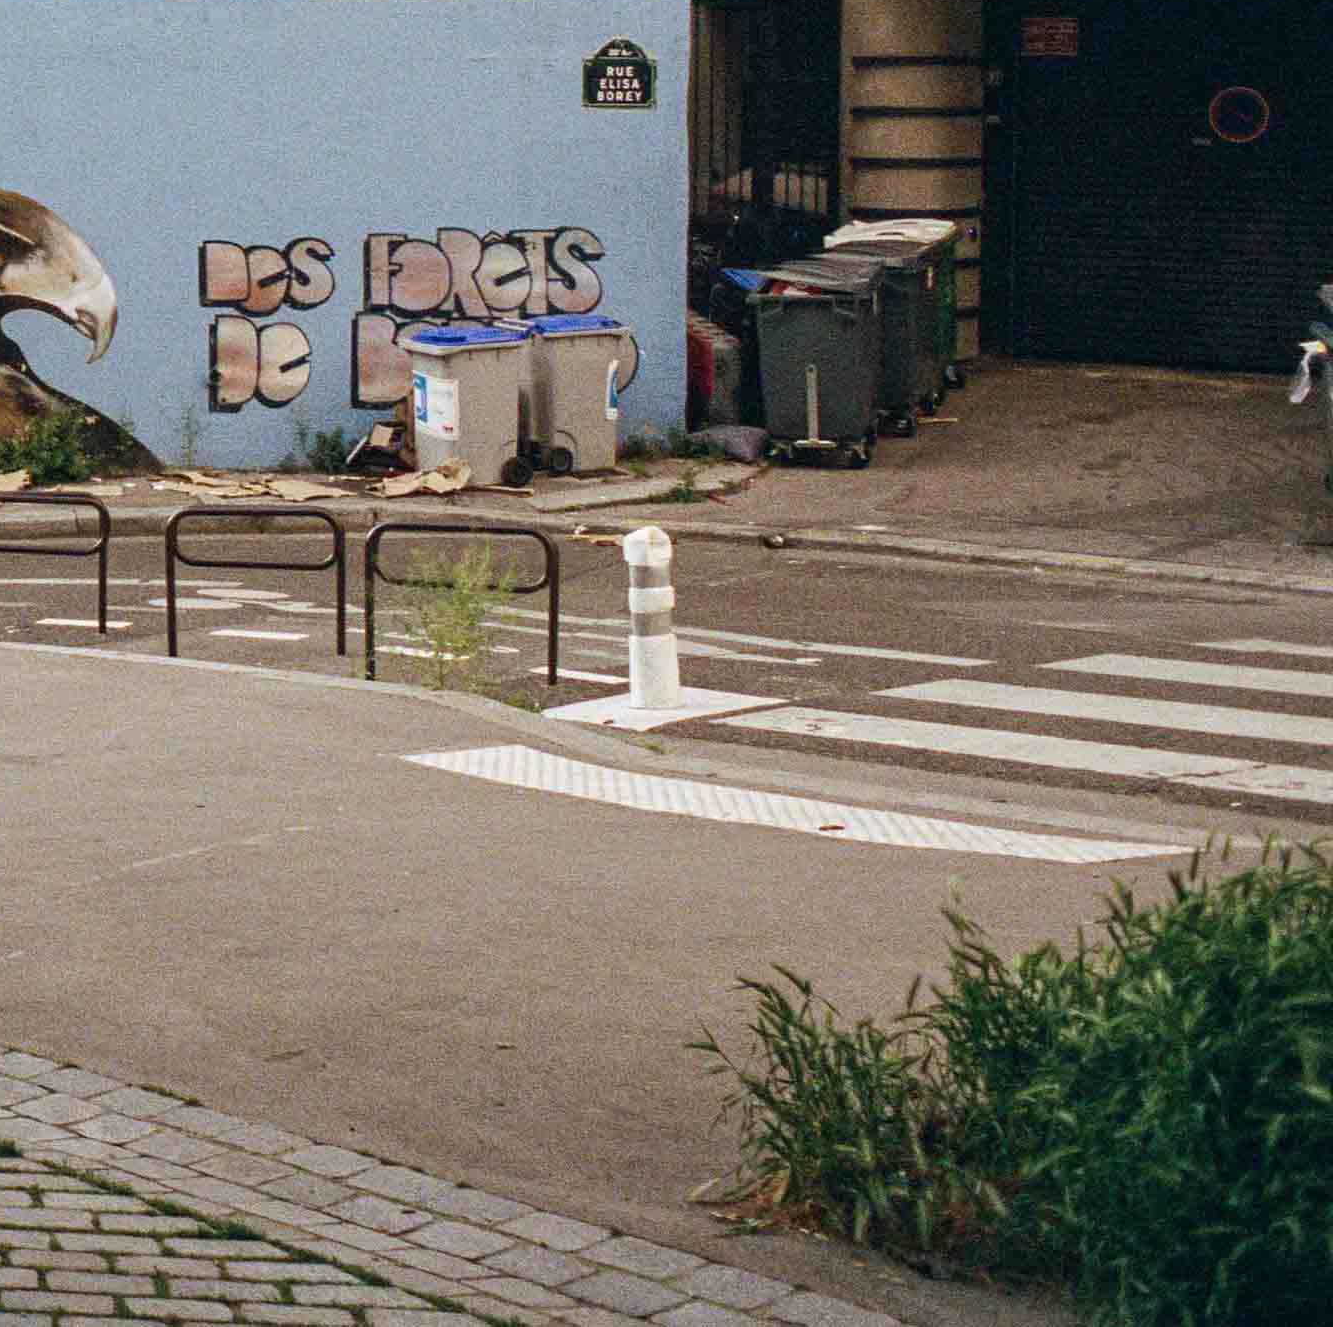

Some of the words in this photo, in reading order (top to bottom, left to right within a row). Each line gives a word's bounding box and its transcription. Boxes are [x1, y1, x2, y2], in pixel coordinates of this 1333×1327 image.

[606, 65, 635, 77] RUE
[599, 78, 640, 90] ELISA
[596, 90, 643, 102] BOREY
